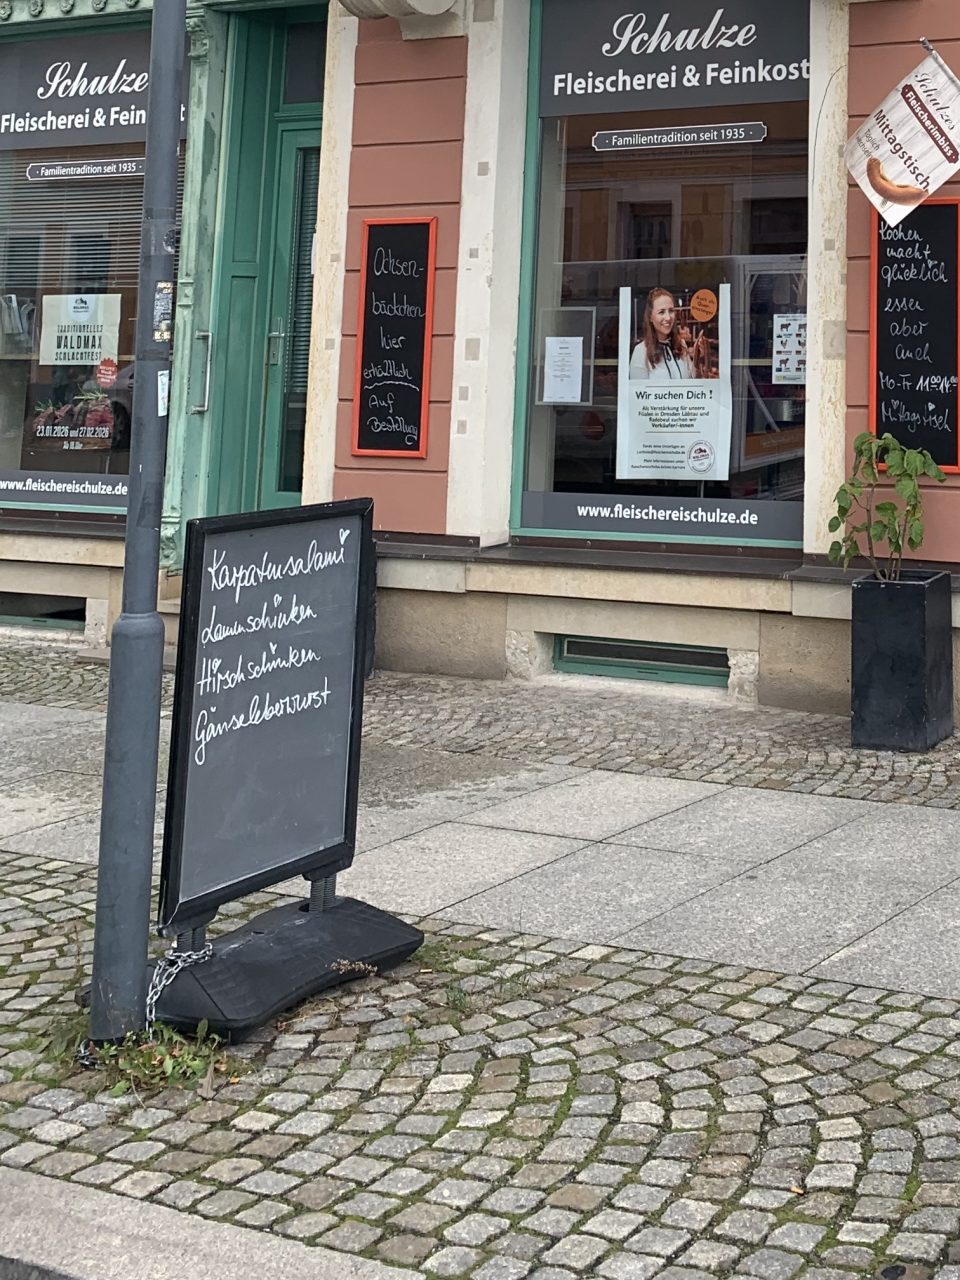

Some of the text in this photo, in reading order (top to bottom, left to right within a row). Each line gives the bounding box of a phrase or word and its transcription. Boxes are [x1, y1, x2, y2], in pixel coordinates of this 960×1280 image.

[601, 8, 757, 57] Schulze
[37, 58, 149, 100] Schulze
[553, 58, 811, 95] Fleischerei & Feinkost
[0, 107, 90, 133] Fleischerei
[93, 107, 106, 127] &
[905, 90, 954, 158] Fleischerimbiss
[611, 127, 745, 146] Familientradition seit 1935
[873, 108, 931, 191] Mittagstisch
[40, 162, 136, 176] Familientradition seit 1935
[879, 221, 923, 241] Kochen
[887, 243, 931, 259] macht
[881, 261, 948, 287] glücklich
[372, 291, 425, 318] bäckchen
[884, 298, 924, 312] essen
[380, 326, 406, 350] hier
[890, 318, 928, 337] aber
[57, 335, 102, 350] WALDMAX
[363, 359, 412, 380] erhältlich
[368, 392, 394, 413] Auf
[635, 391, 651, 400] Wir
[654, 391, 684, 400] suchen
[686, 390, 706, 400] Dich
[366, 417, 418, 445] Bestellung
[0, 478, 128, 495] www.fleischereischulze.de
[577, 503, 758, 525] www.fleischereischulze.de
[208, 528, 350, 604] Karpatensalami
[195, 676, 331, 765] Gänseleberwurst
